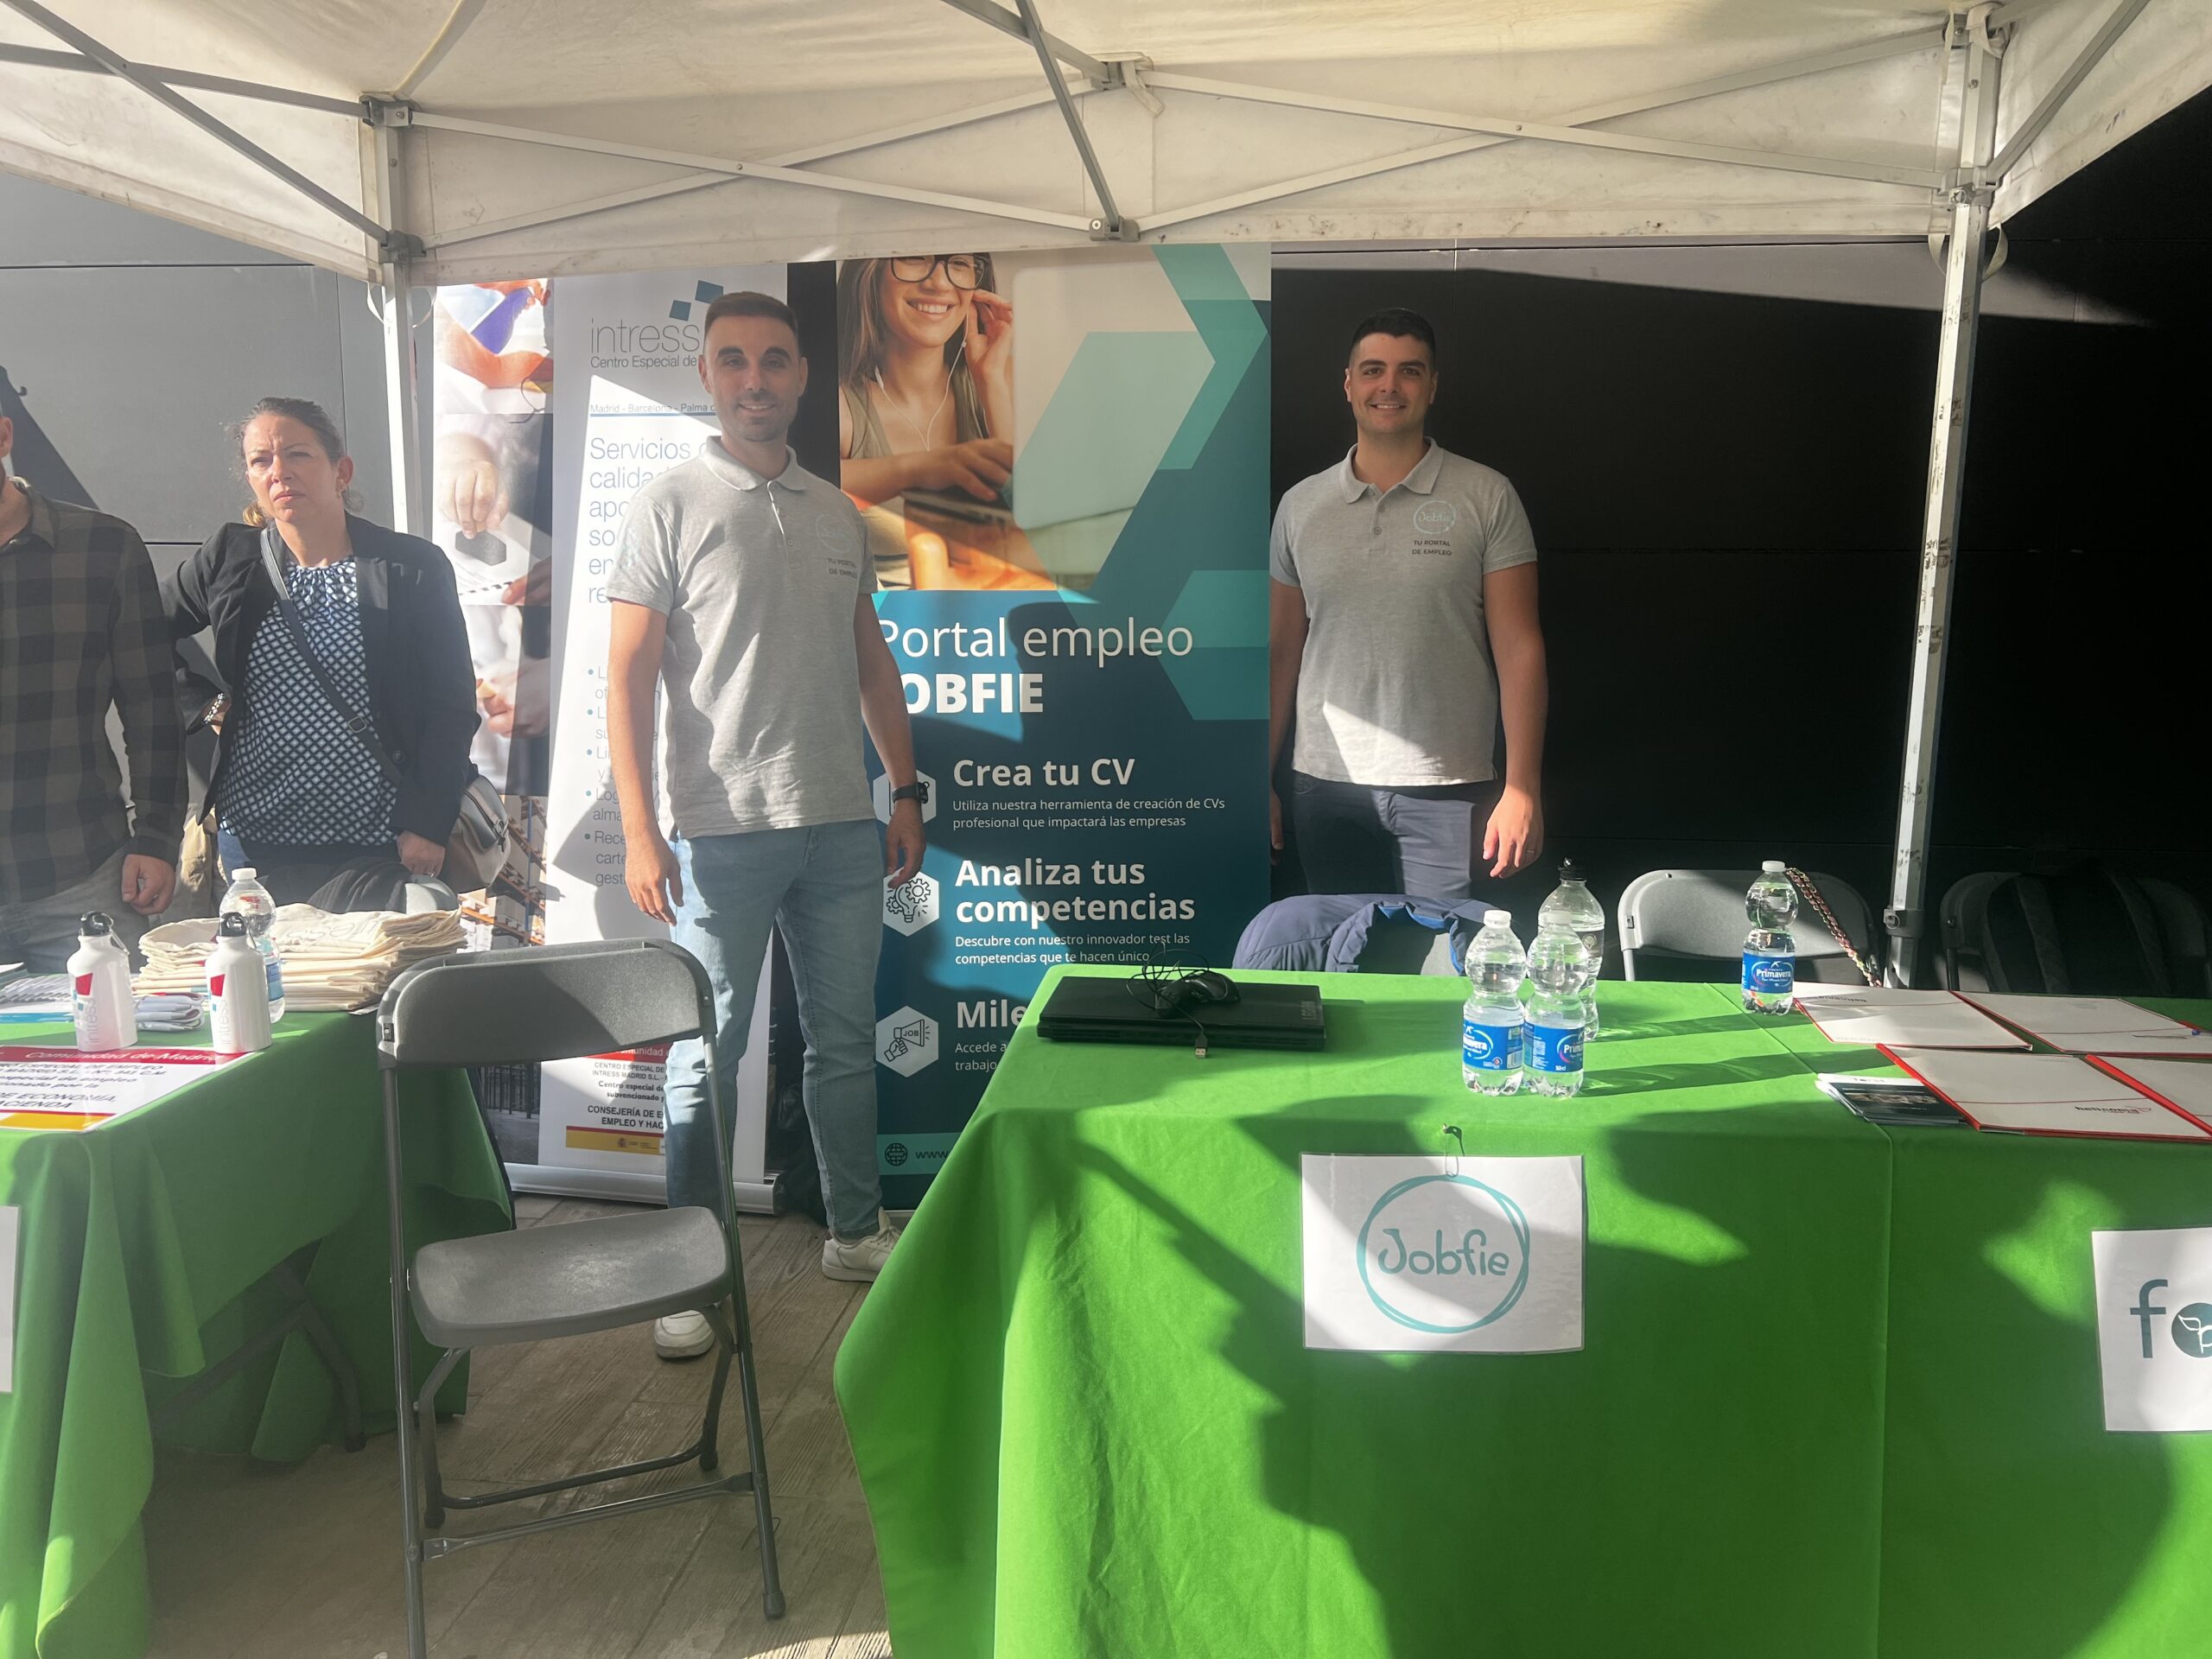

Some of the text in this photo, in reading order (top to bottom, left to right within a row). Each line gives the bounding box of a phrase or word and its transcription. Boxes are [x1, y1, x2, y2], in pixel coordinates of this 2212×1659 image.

[590, 318, 700, 353] intress
[590, 355, 697, 370] Centro Especial de
[590, 404, 620, 413] Madrid
[628, 404, 672, 412] Barcelona
[590, 437, 691, 460] Servicios
[878, 616, 1193, 668] Portal empleo
[953, 758, 1136, 786] Crea tu CV
[952, 798, 1225, 811] Utiliza nuestra herramienta de creación de CVs
[952, 815, 1186, 831] profesional que impactará las empresas
[955, 857, 1146, 887] Analiza tus
[956, 892, 1196, 930] competencias
[955, 932, 1190, 947] Descubre con nuestro innovador test las
[955, 950, 1150, 966] competencias que te hacen único
[1756, 969, 1791, 978] Primavera
[955, 1041, 996, 1053] Accede
[623, 1064, 654, 1072] ESPECIAL
[955, 1060, 997, 1073] trabajo
[607, 1091, 659, 1101] subvencionado
[588, 1104, 641, 1116] CONSEJERÍA
[601, 1116, 636, 1128] EMPLEO
[1377, 1228, 1510, 1277] Jobfie
